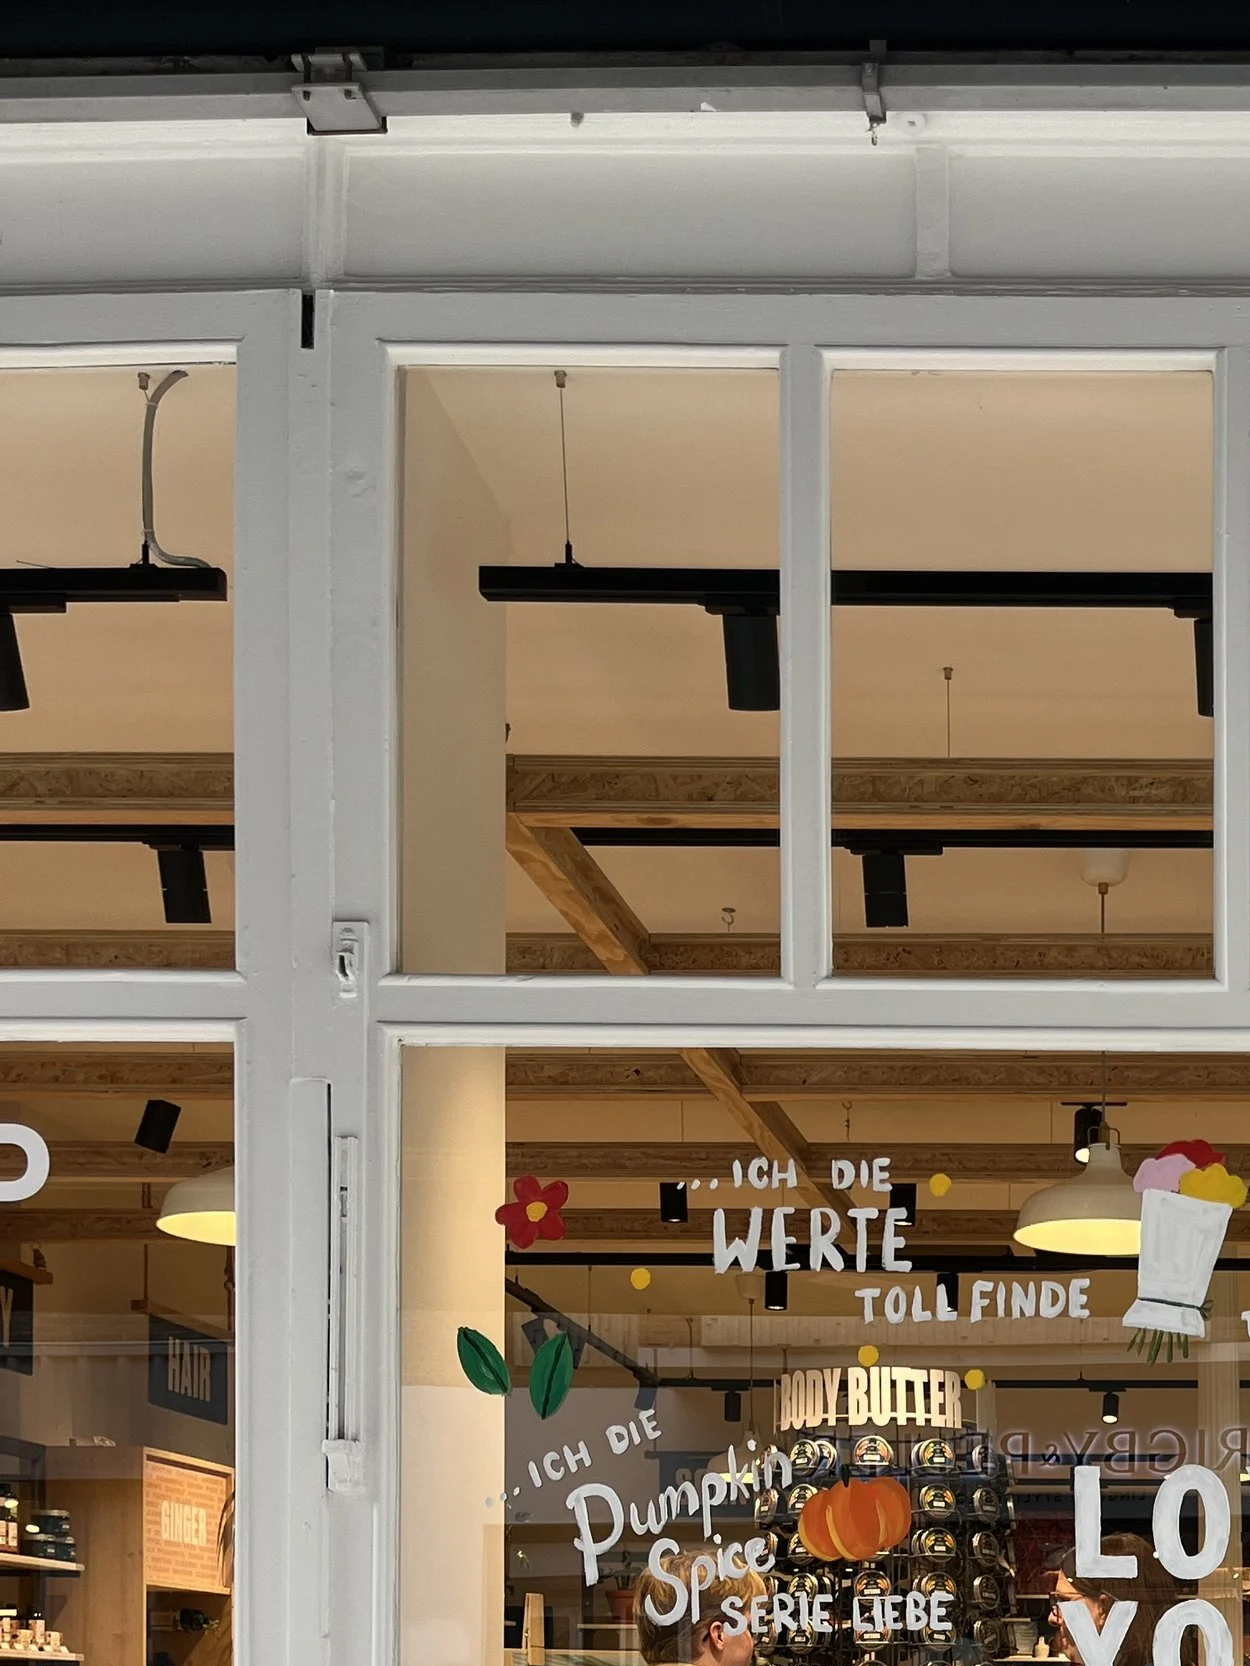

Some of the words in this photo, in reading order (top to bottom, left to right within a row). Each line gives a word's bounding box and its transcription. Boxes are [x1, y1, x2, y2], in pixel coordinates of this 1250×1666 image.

[831, 1157, 893, 1191] DIE
[712, 1205, 912, 1274] WERTE
[854, 1282, 958, 1325] TOLL
[971, 1278, 1091, 1321] FINDE
[167, 1336, 211, 1402] HAIR
[781, 1367, 841, 1431] BODY
[848, 1366, 962, 1429] BUTTER
[605, 1408, 662, 1455] DIE
[161, 1500, 206, 1546] GINGER
[566, 1439, 792, 1587] Pumpkin
[644, 1533, 776, 1627] Spice
[719, 1592, 834, 1636] SERIE
[853, 1591, 954, 1631] LIEBE
